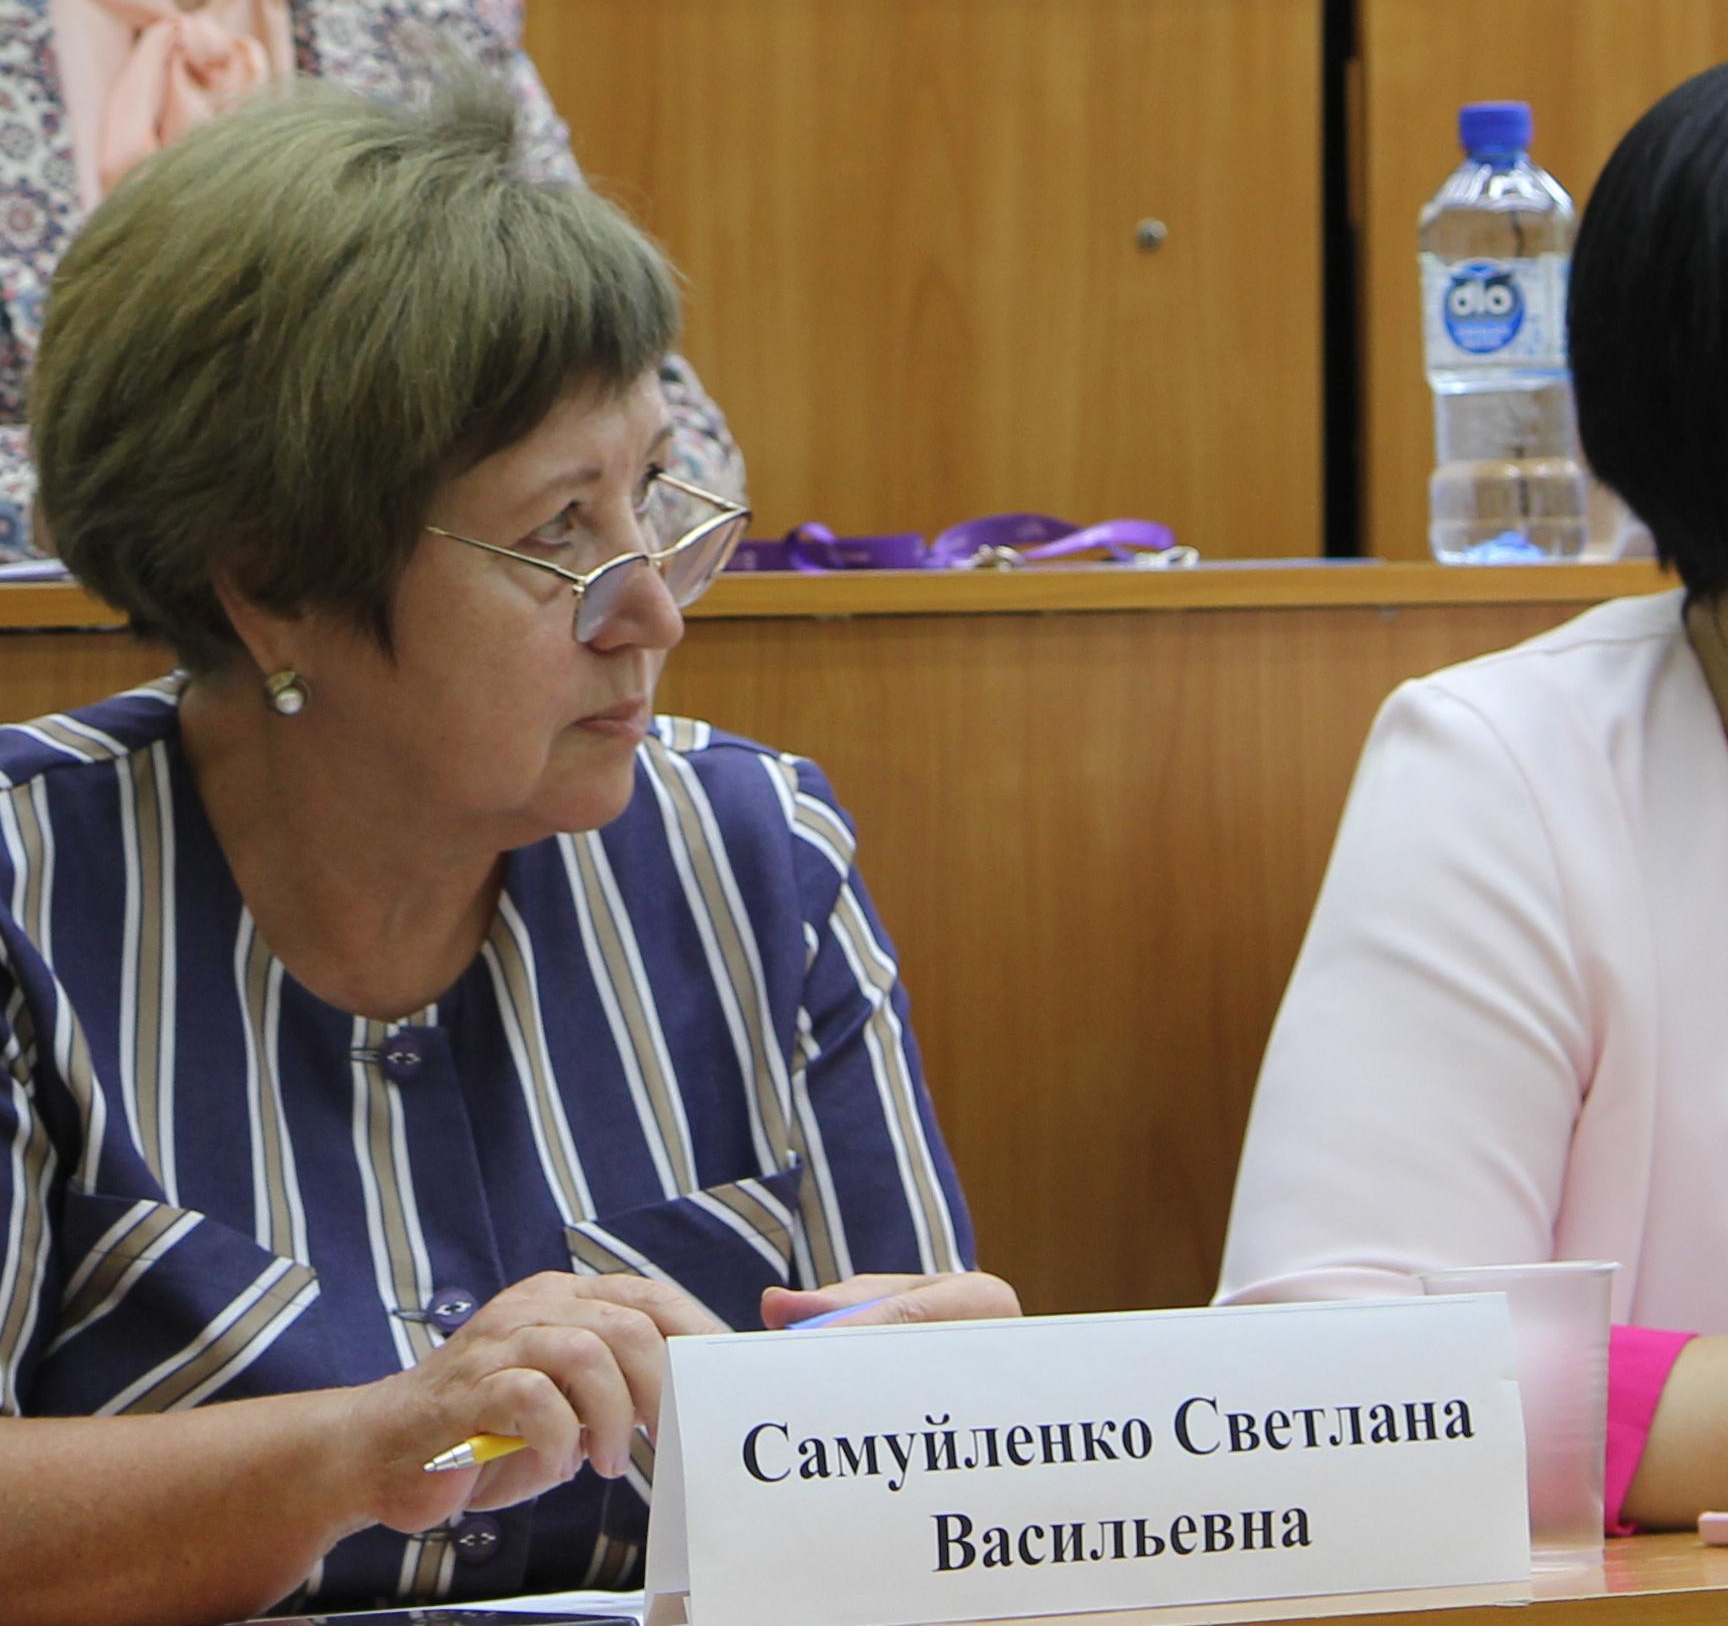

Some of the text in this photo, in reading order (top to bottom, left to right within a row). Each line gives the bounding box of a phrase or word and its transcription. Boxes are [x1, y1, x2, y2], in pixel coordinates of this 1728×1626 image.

[741, 1395, 1476, 1492] Самуйленко Светлана
[931, 1507, 1313, 1573] Васильевна
